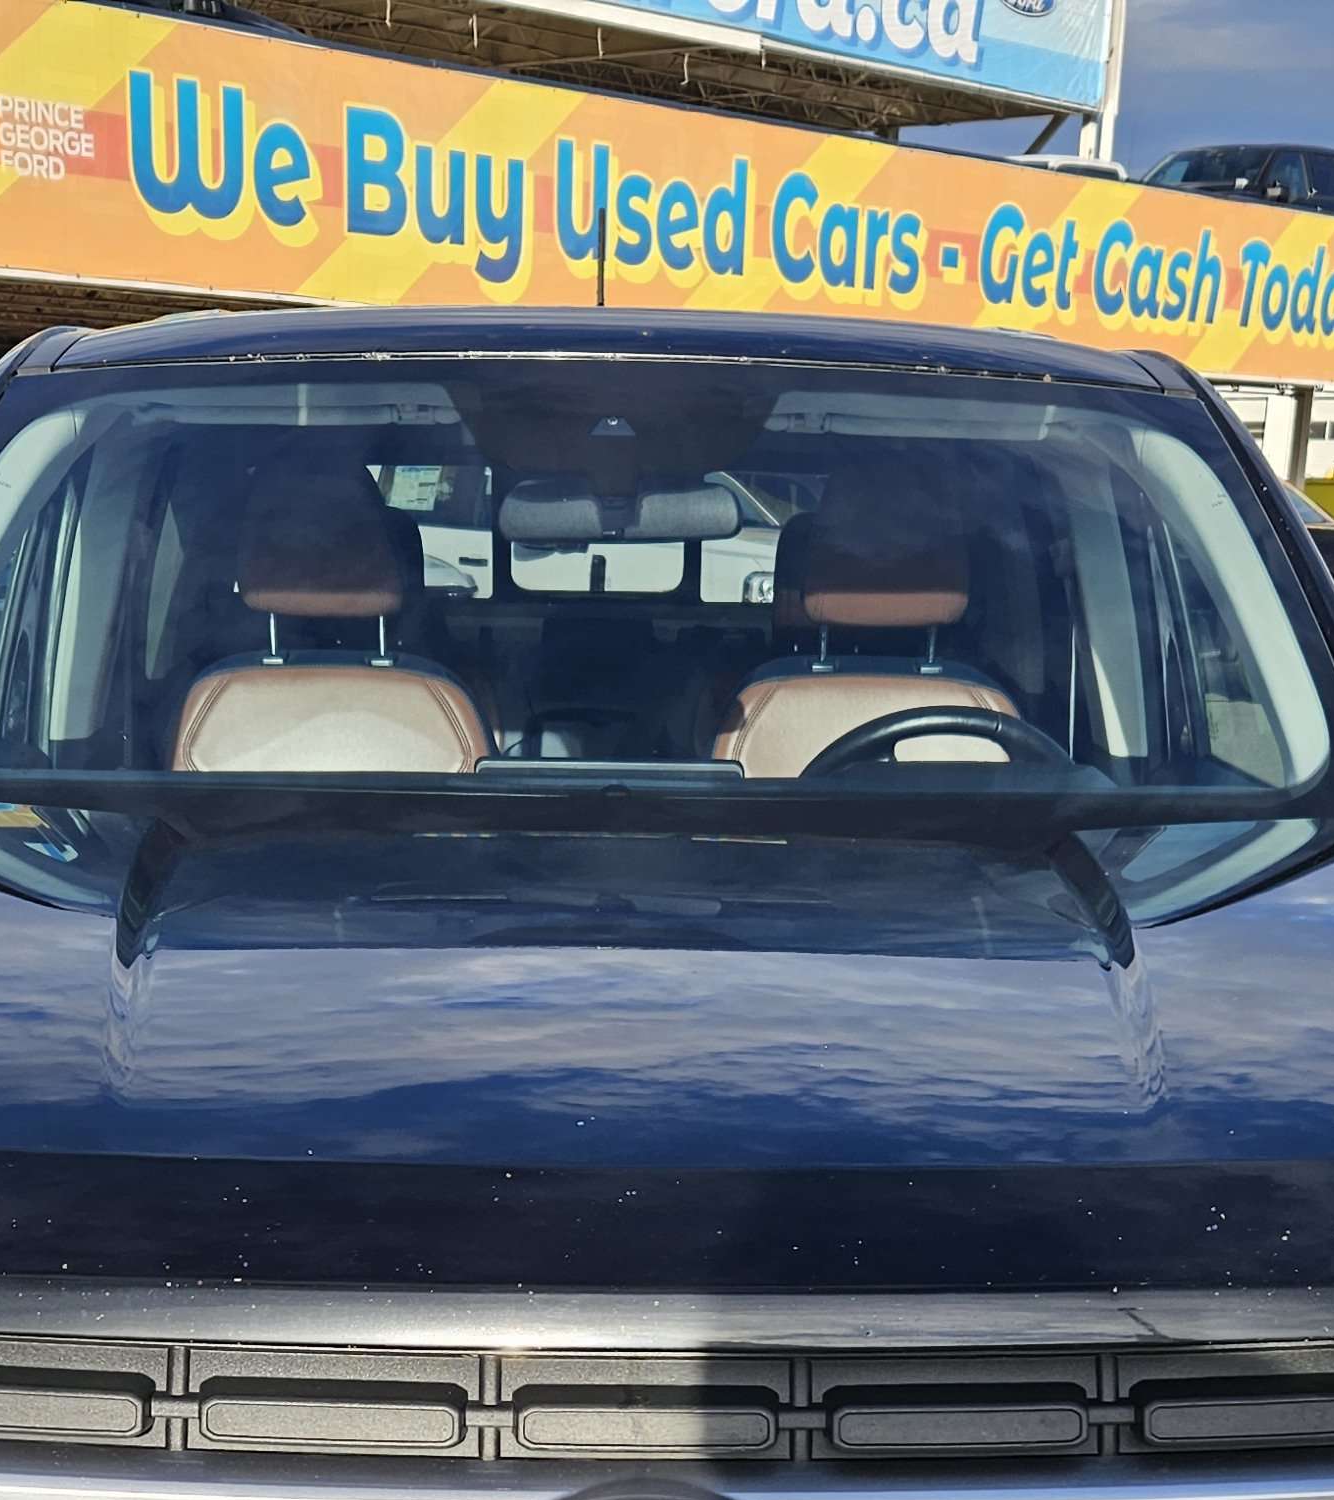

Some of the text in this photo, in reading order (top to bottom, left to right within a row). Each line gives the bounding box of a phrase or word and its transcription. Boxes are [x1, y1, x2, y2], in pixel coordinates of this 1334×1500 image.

[0, 150, 66, 181] FORD
[128, 69, 311, 228] We
[346, 105, 525, 284] Buy
[556, 138, 749, 277] Used
[771, 171, 922, 295] Cars
[980, 203, 1079, 311] Get
[1093, 219, 1222, 325] Cash
